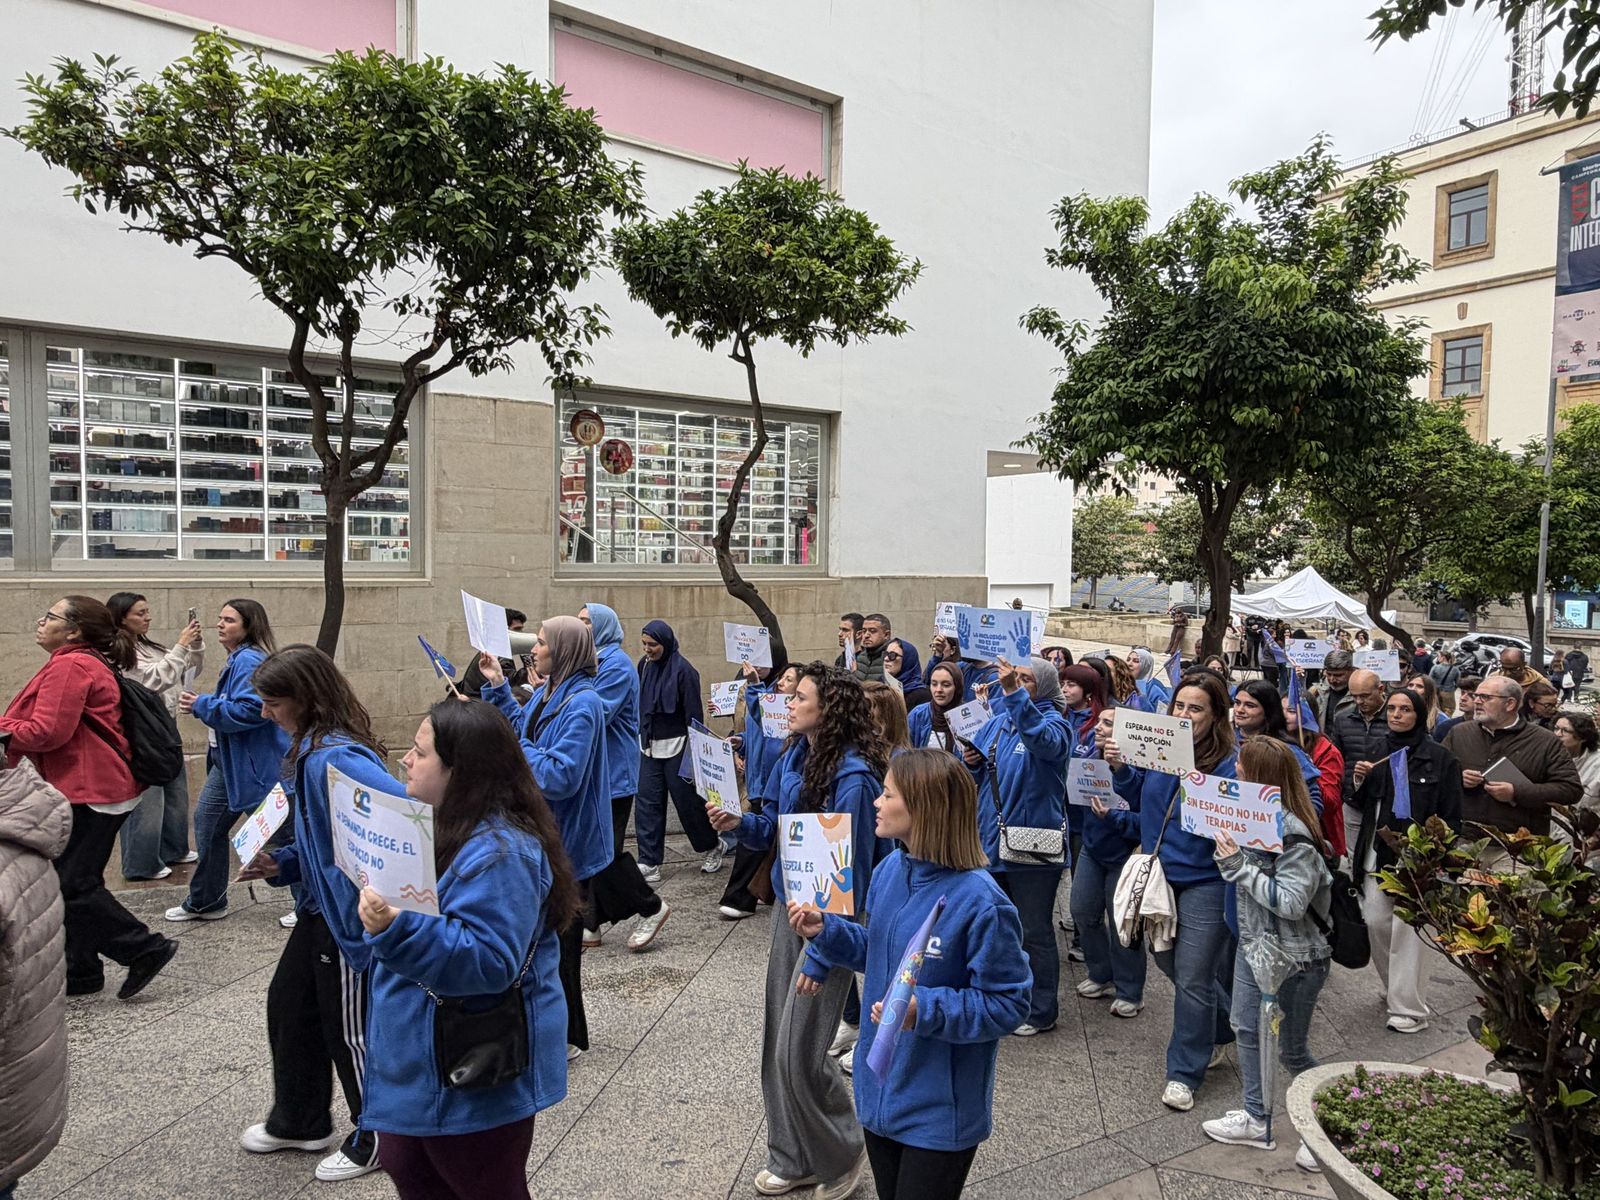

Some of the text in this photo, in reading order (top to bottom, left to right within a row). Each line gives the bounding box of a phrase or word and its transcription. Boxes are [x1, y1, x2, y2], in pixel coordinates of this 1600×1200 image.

[1125, 721, 1174, 737] ESPERAR NO ES
[1077, 777, 1111, 788] AUTISMO
[1187, 797, 1272, 823] SIN ESPACIO NO HAY
[1205, 815, 1247, 833] TERAPIAS
[367, 830, 400, 854] CRECE,
[402, 842, 416, 856] EL
[370, 855, 384, 870] NO
[805, 862, 814, 873] ES
